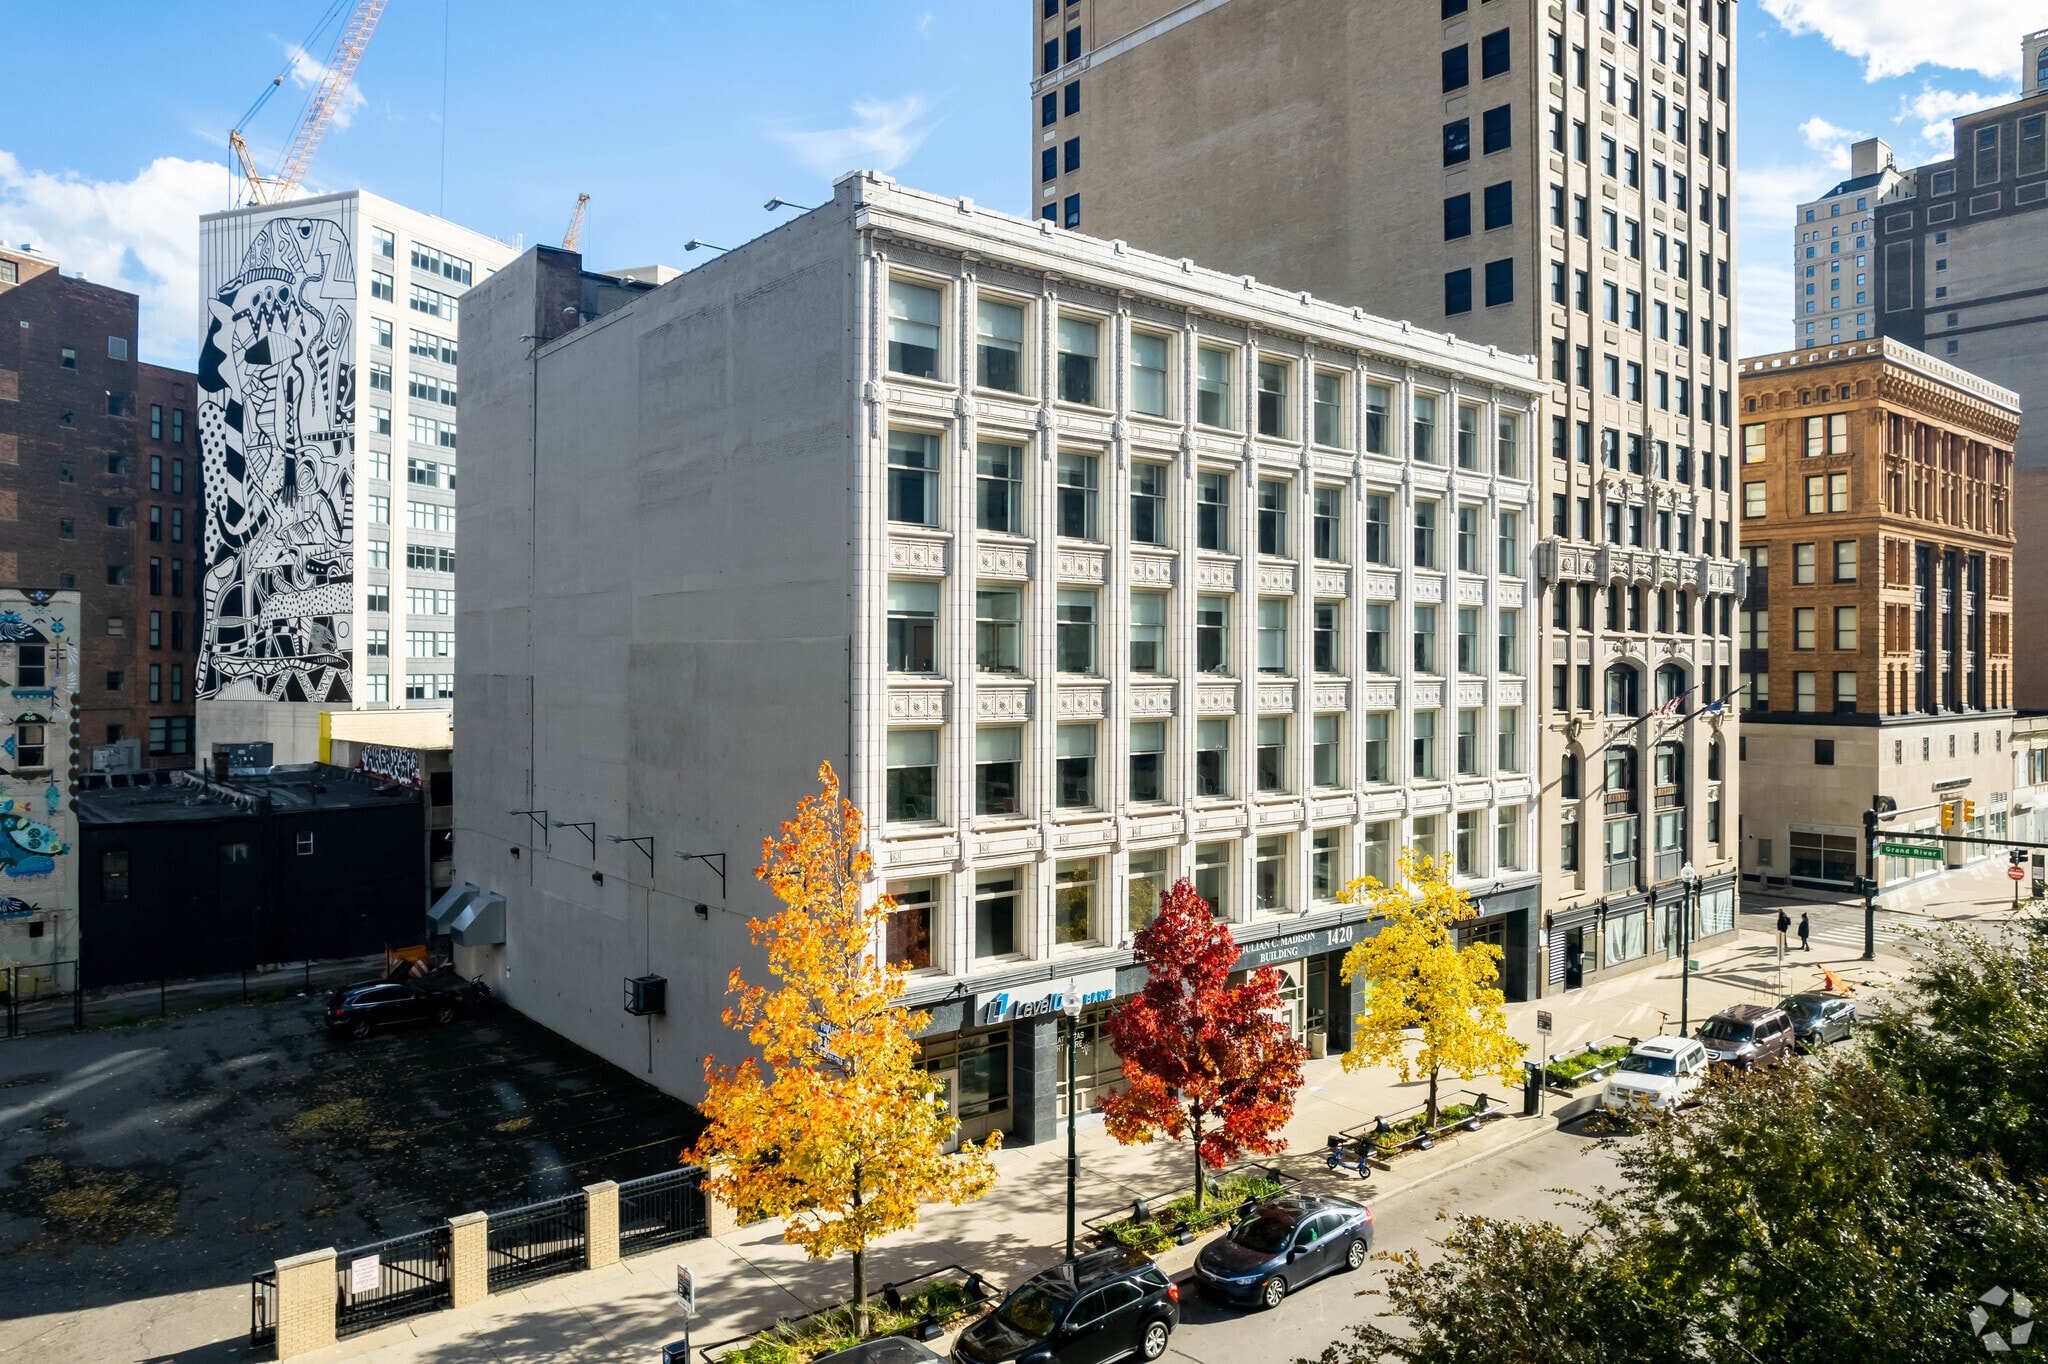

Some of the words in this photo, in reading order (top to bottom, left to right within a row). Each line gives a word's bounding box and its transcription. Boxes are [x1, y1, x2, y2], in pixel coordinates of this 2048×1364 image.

[1885, 846, 1910, 854] Grand
[1913, 849, 1937, 857] River
[1242, 941, 1270, 953] JULIAN
[1271, 938, 1279, 948] C.
[1281, 932, 1315, 946] MADISON
[1327, 925, 1353, 946] 1420
[1260, 946, 1298, 963] BUILDING
[1015, 993, 1064, 1019] LevelO
[1084, 989, 1113, 1004] BANK
